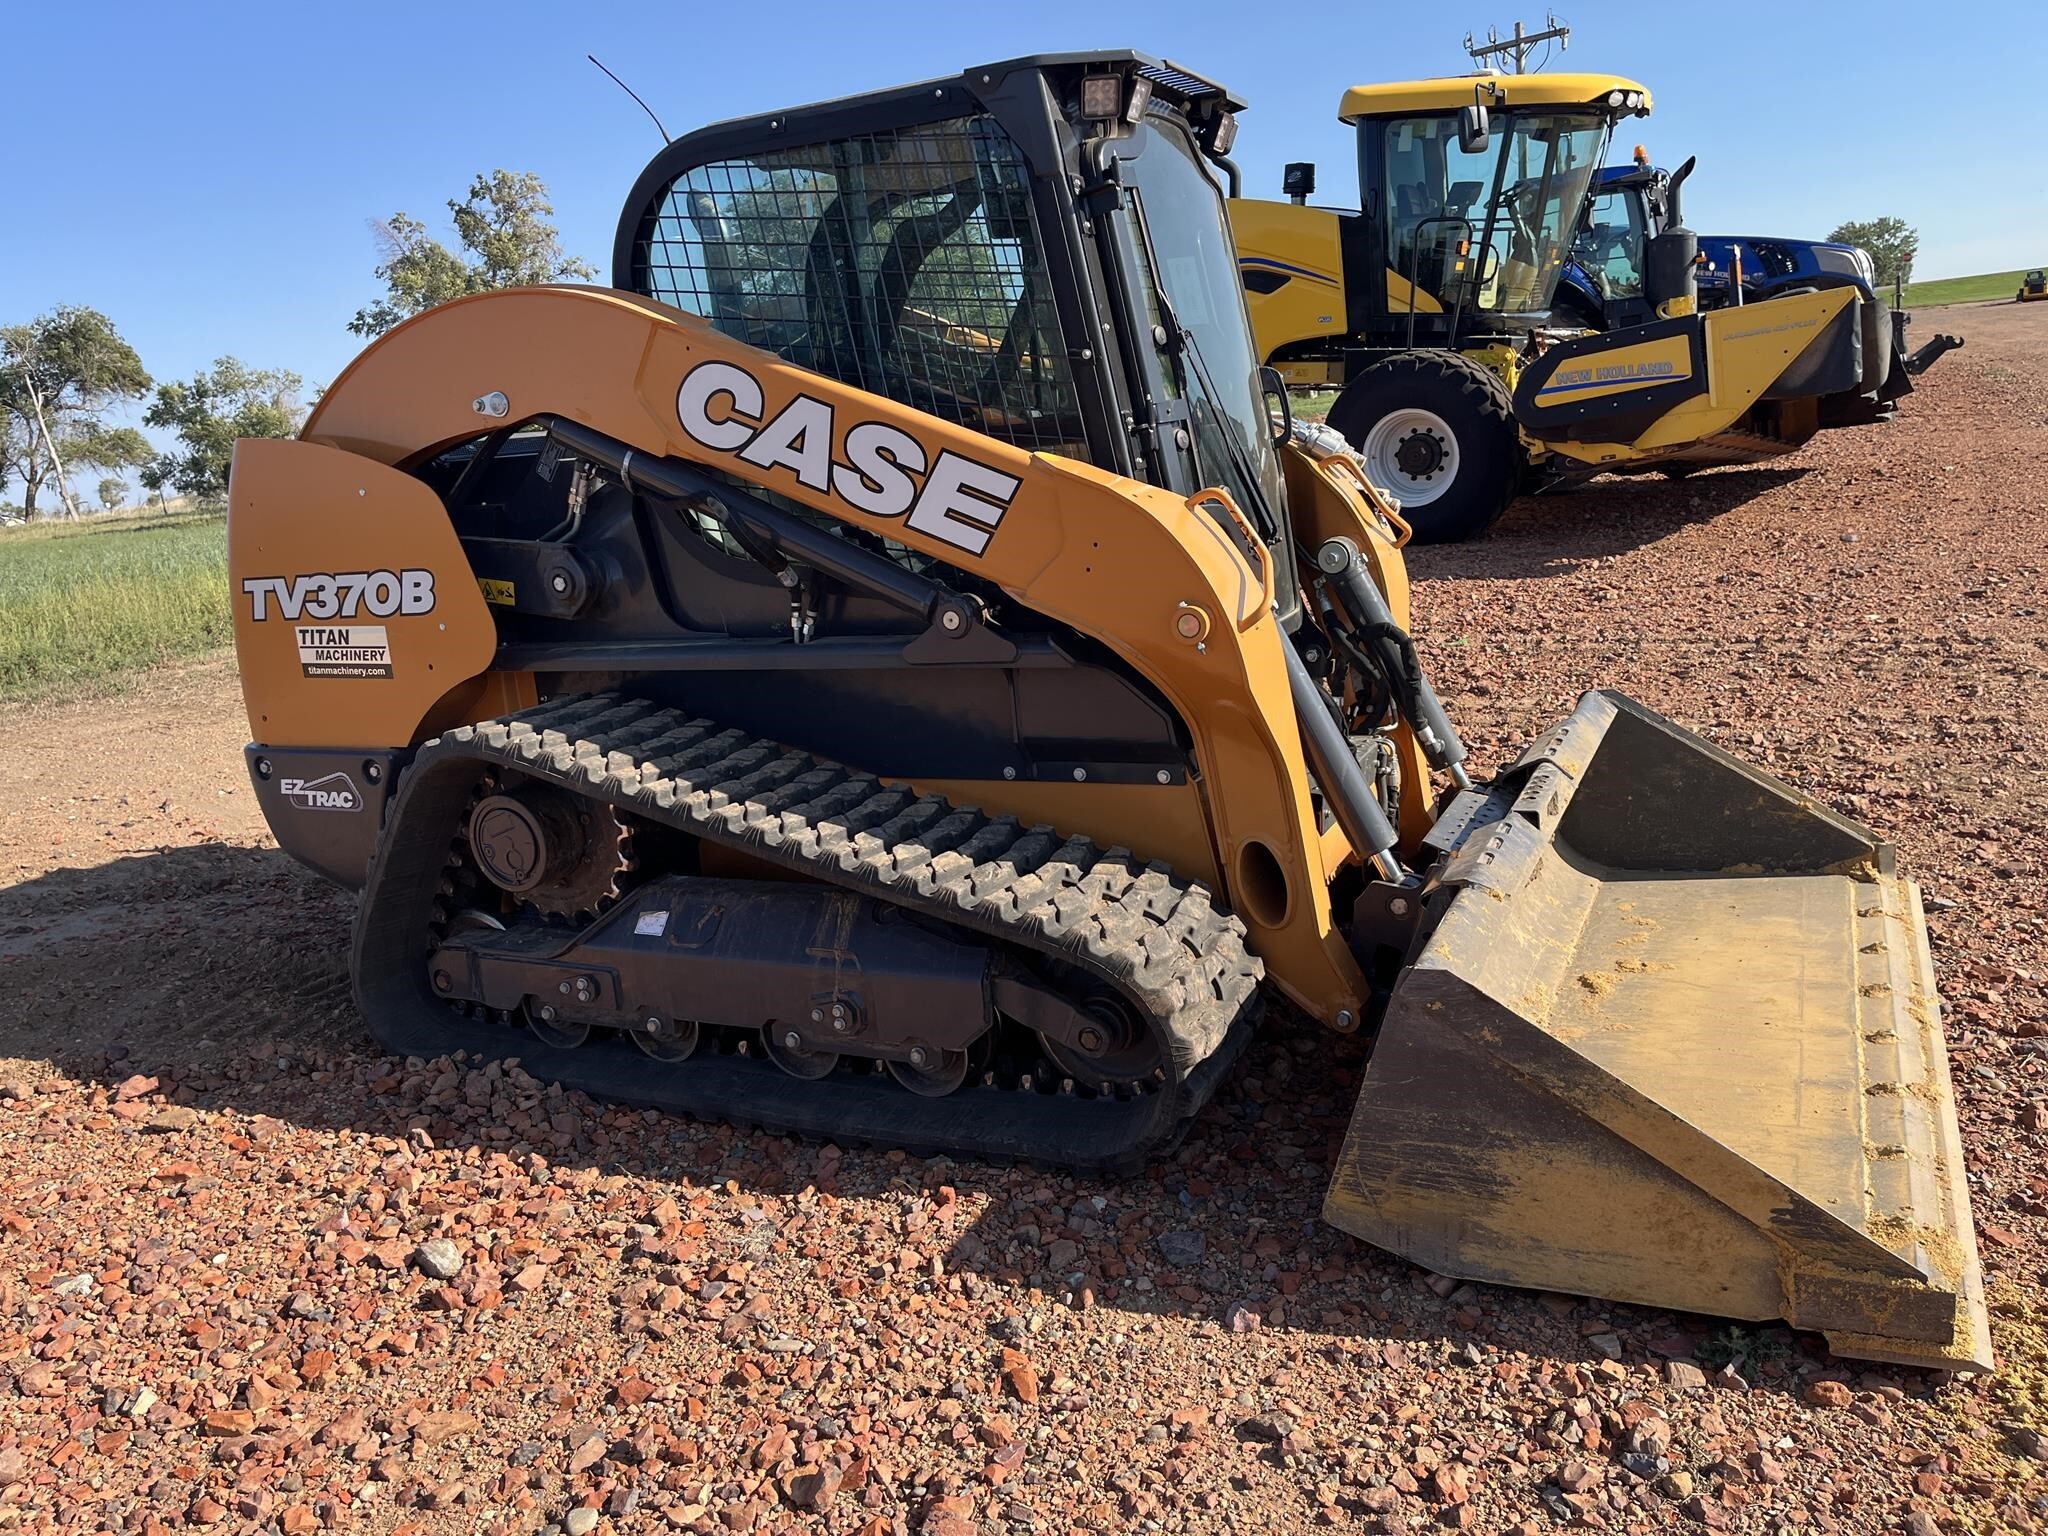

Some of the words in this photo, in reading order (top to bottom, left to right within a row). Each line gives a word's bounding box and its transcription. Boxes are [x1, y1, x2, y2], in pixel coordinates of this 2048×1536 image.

[1556, 368, 1592, 385] NEW
[1596, 361, 1673, 380] HOLLAND
[676, 359, 1024, 558] CASE
[243, 568, 435, 622] TV370B
[299, 629, 350, 646] TITAN
[315, 650, 386, 662] MACHINERY
[308, 666, 386, 677] titanmachinery.com
[280, 779, 304, 795] EZ
[304, 789, 353, 808] TRAC
